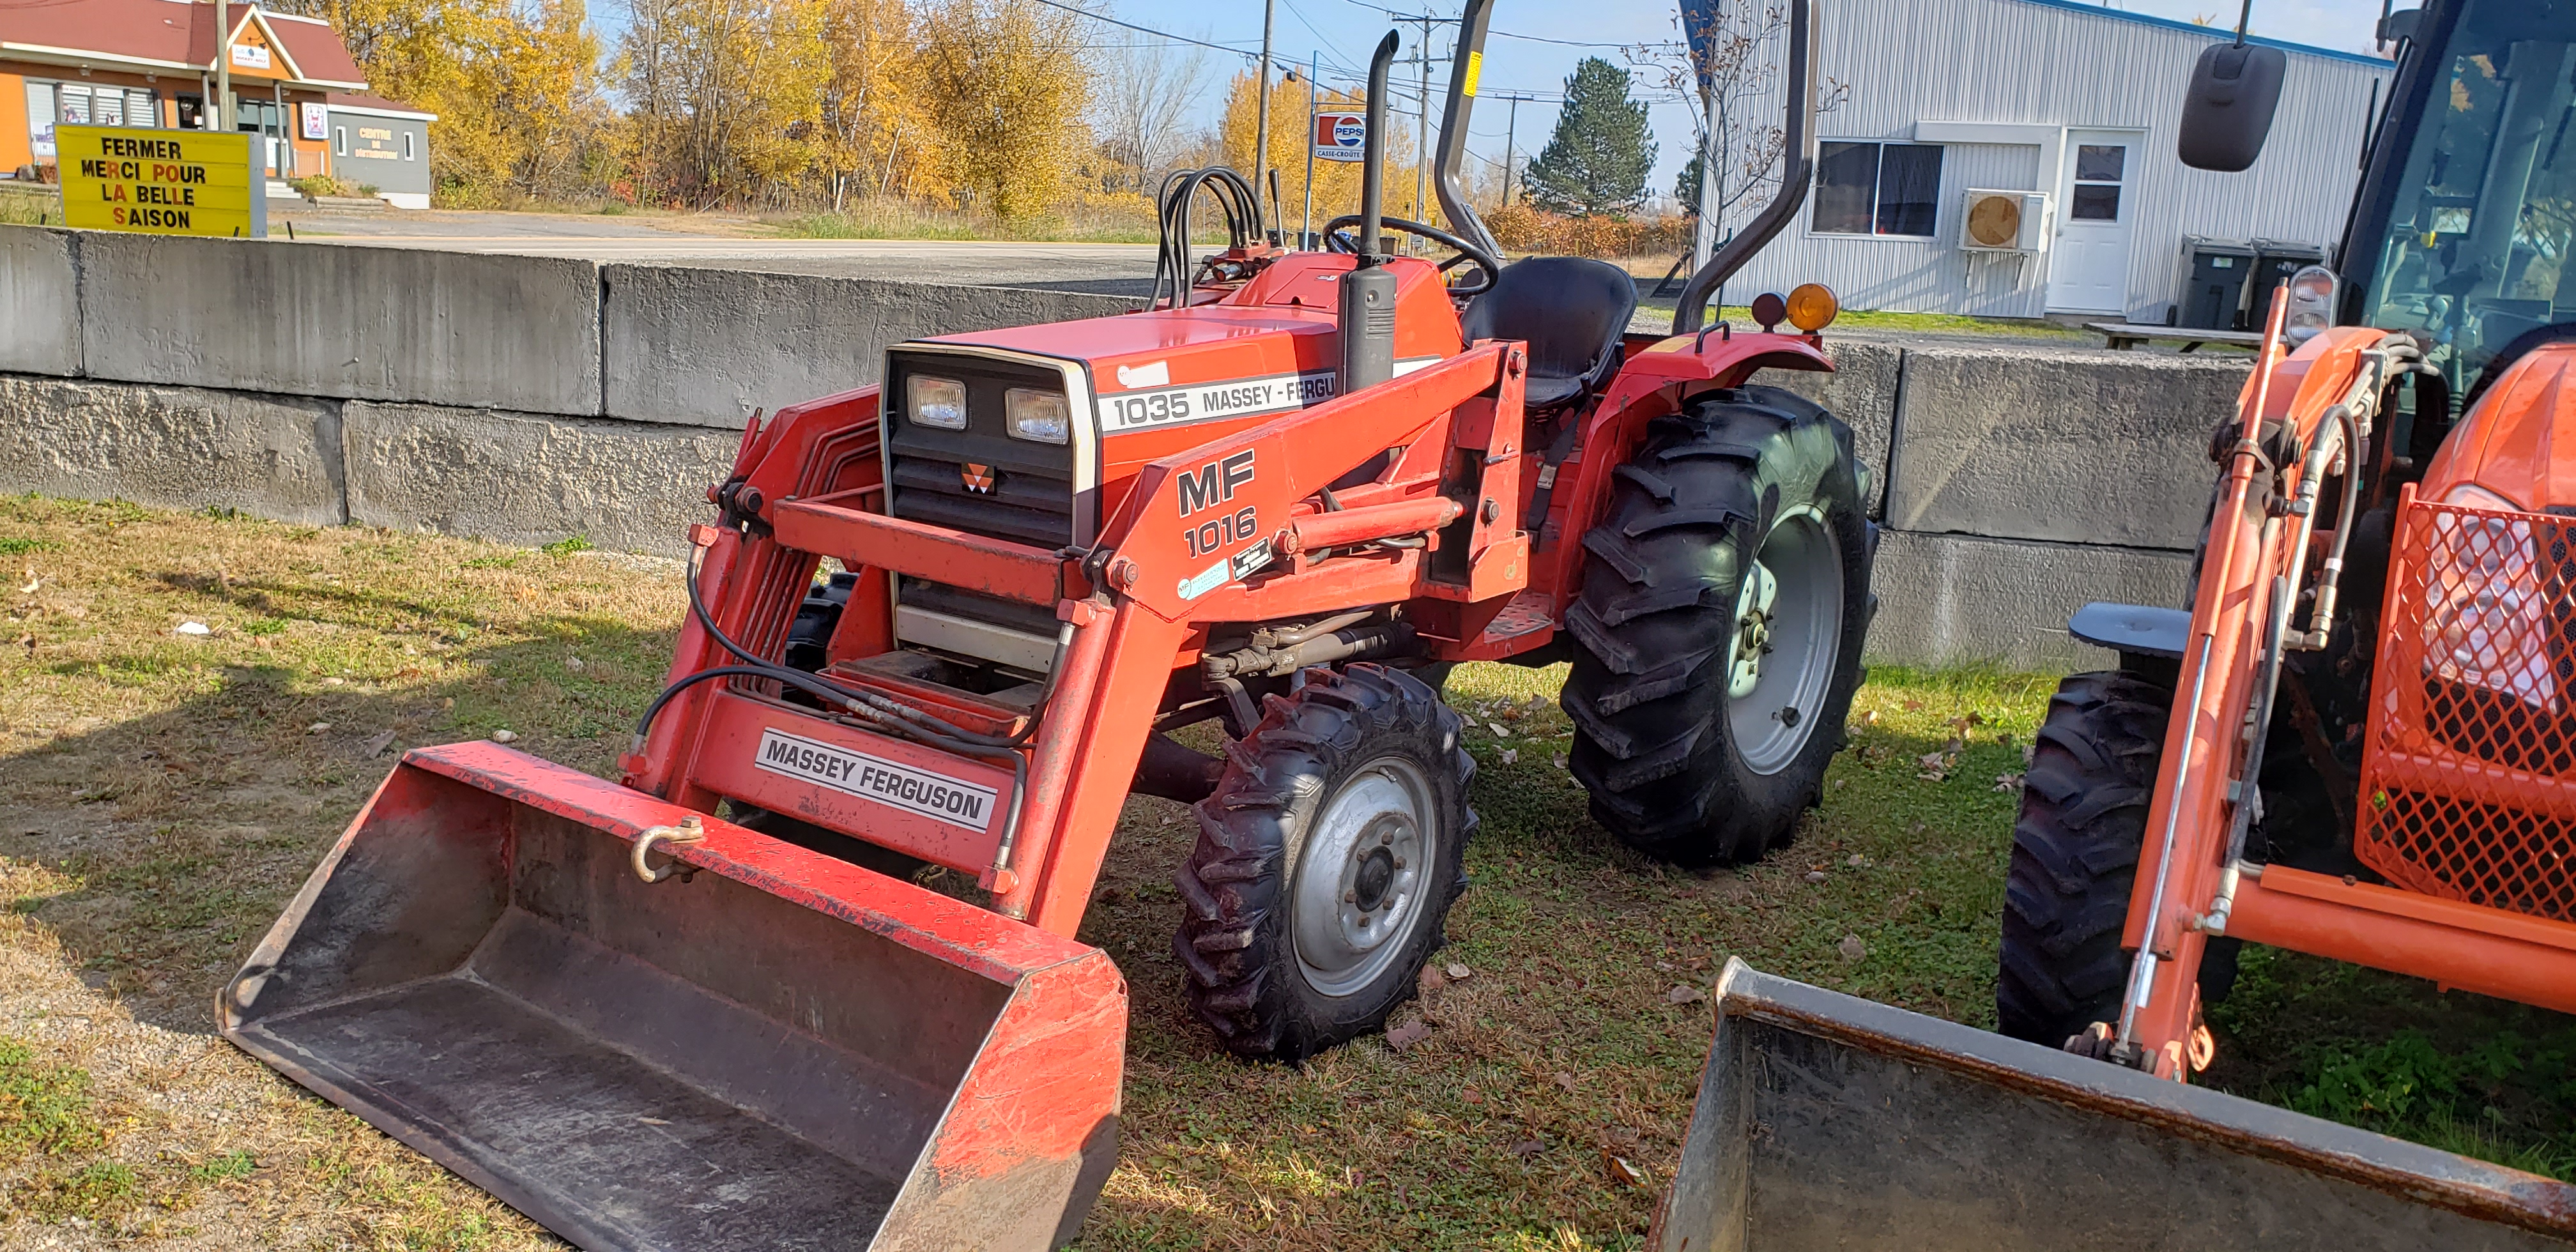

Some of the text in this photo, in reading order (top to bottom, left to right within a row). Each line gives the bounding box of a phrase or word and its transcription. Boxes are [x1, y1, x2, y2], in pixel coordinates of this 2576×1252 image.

[359, 127, 392, 141] CENTRE
[1335, 128, 1365, 136] PEPSI
[101, 137, 182, 160] FERMER
[81, 160, 206, 184] MERCI POUR
[102, 183, 195, 207] LA BELLE
[1114, 392, 1190, 426] 1035
[1202, 385, 1273, 412] MASSEY
[1177, 448, 1255, 519] MF
[1184, 505, 1257, 559] 1016
[1179, 582, 1189, 593] MF
[766, 739, 983, 820] MASSEY FERGUSON
